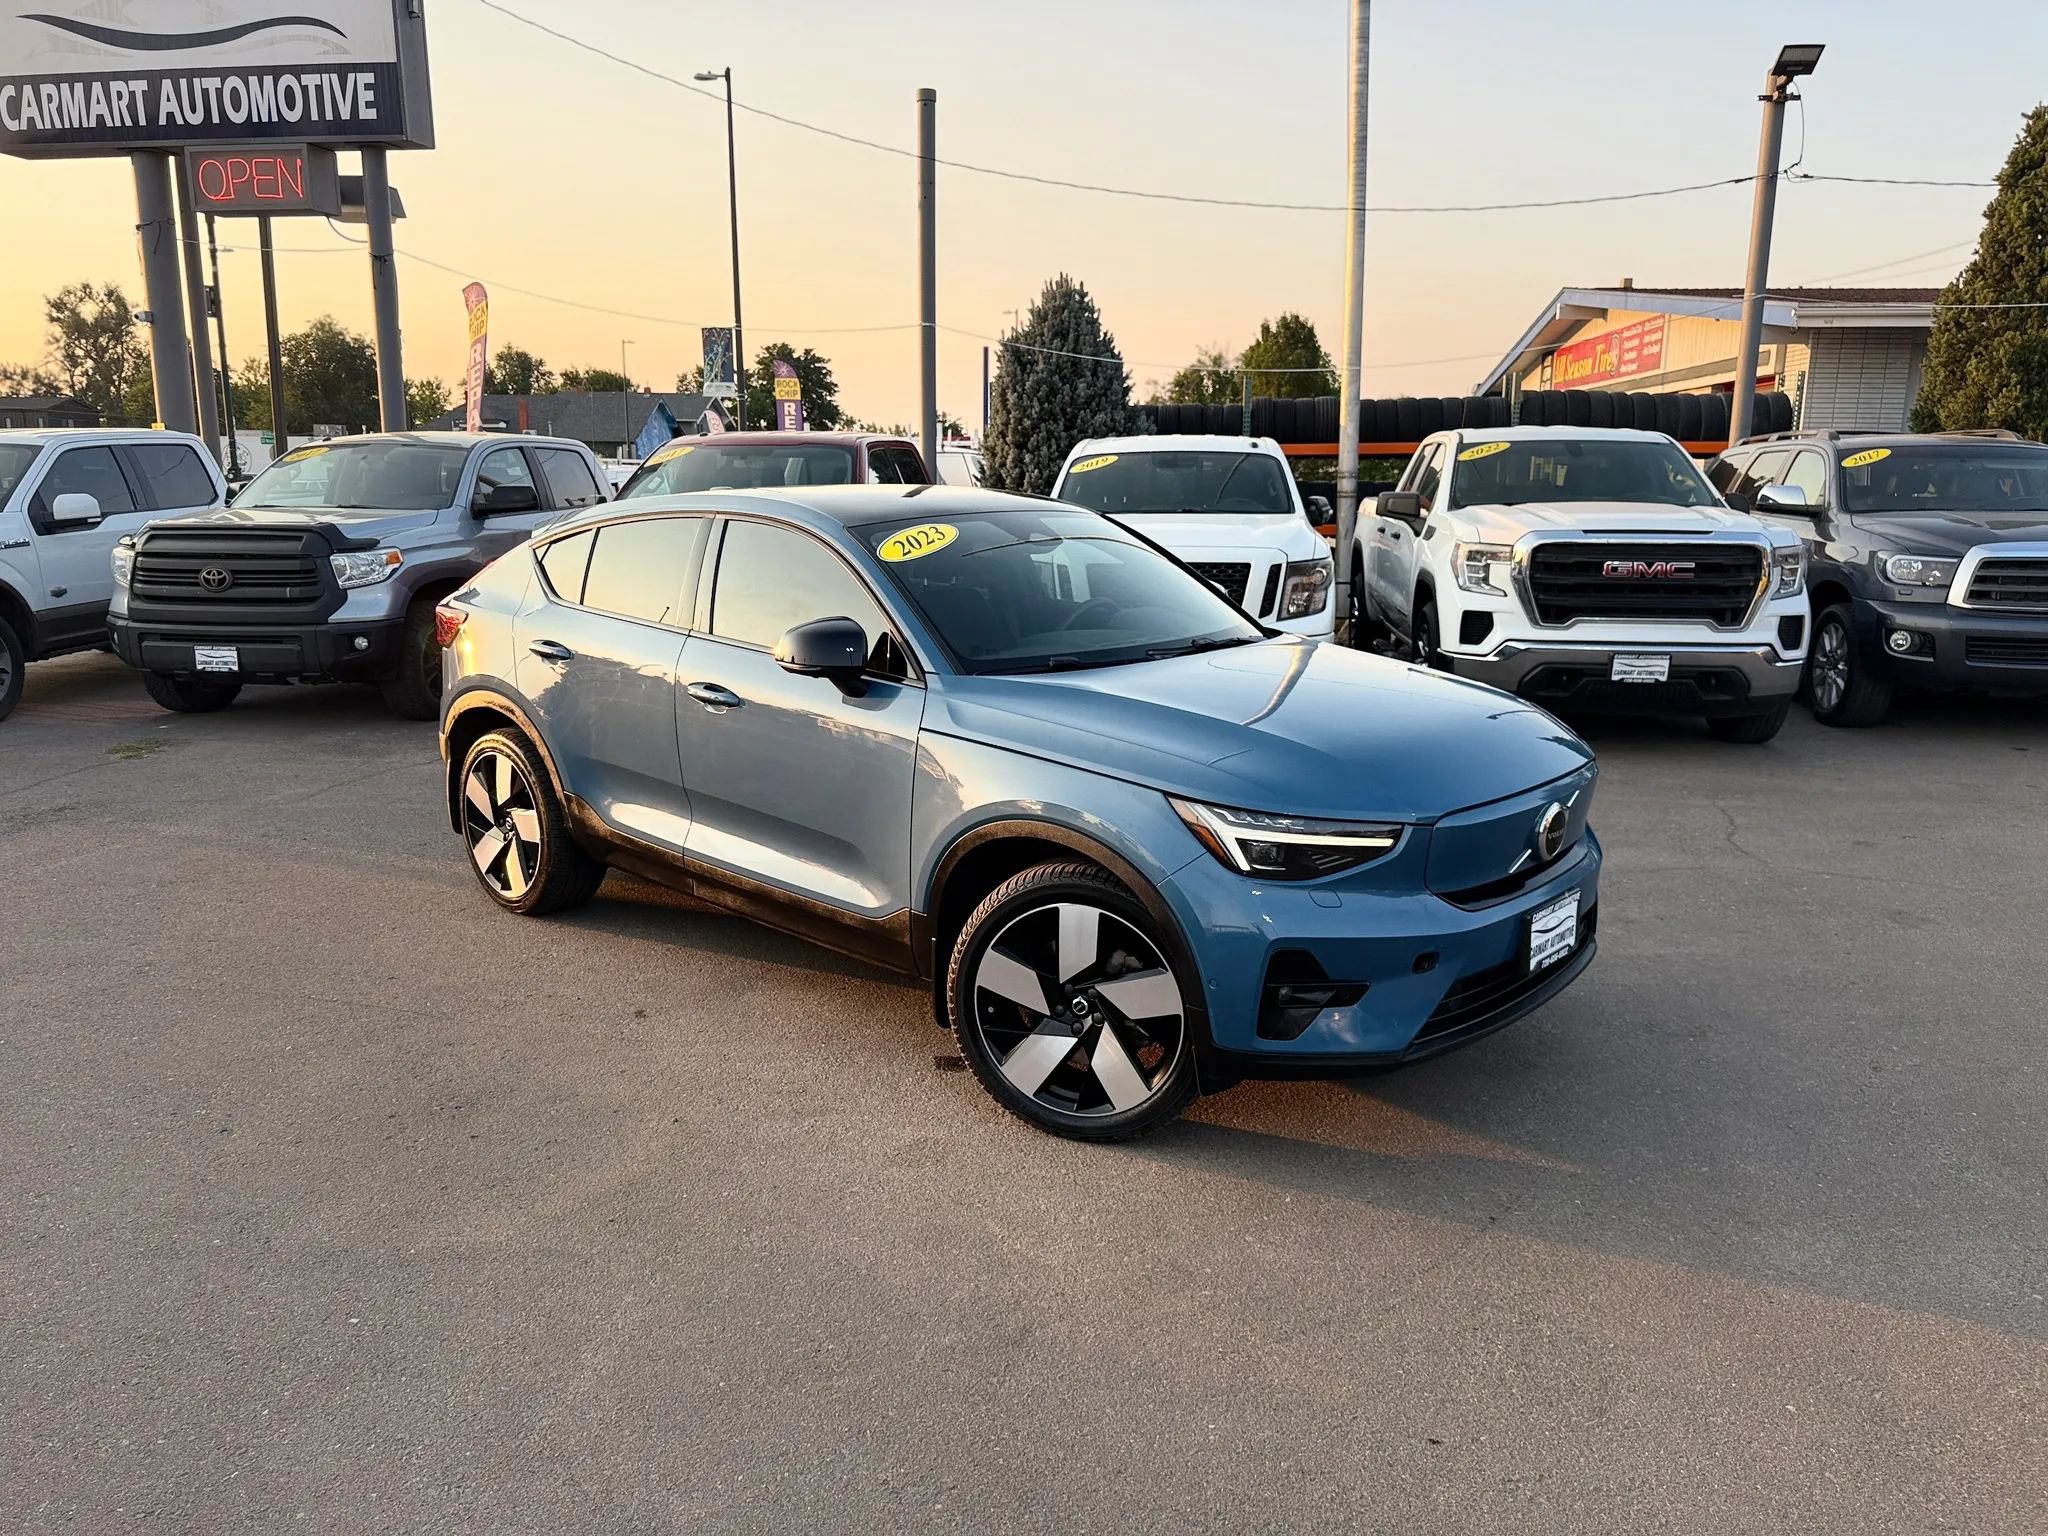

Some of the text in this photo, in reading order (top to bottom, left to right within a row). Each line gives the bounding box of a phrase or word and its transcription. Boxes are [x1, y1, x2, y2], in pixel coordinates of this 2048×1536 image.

[0, 72, 378, 131] CARMART AUTOMOTIVE
[199, 157, 303, 200] OPEN
[777, 380, 798, 389] ROCK
[778, 389, 799, 398] CHIP
[783, 402, 797, 431] RE
[1850, 450, 1880, 466] 2017
[892, 526, 946, 557] 2023
[1602, 561, 1695, 579] GMC
